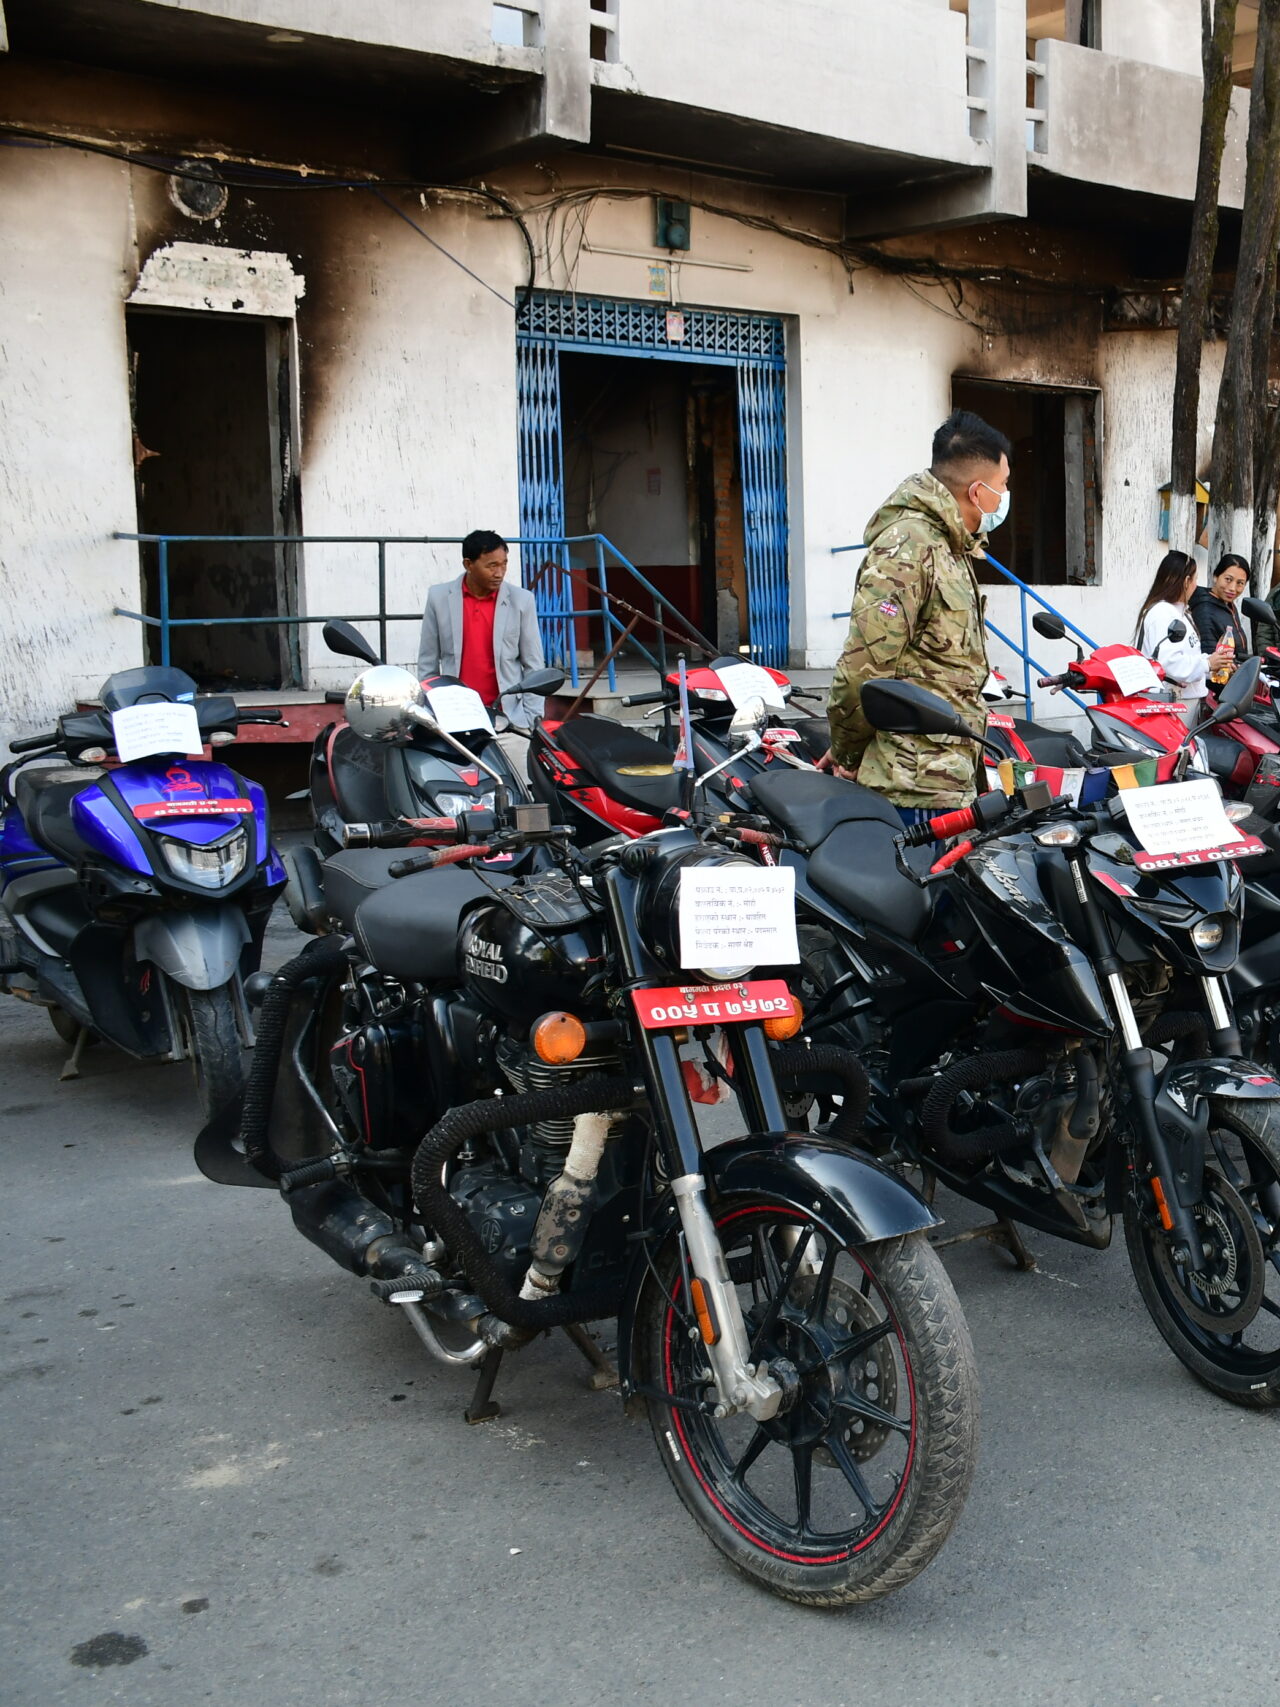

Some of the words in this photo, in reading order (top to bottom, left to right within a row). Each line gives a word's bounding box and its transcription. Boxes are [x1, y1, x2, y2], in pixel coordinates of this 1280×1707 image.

[650, 1003, 699, 1021] ००५
[701, 1002, 722, 1017] प
[725, 997, 790, 1015] ७५७२
